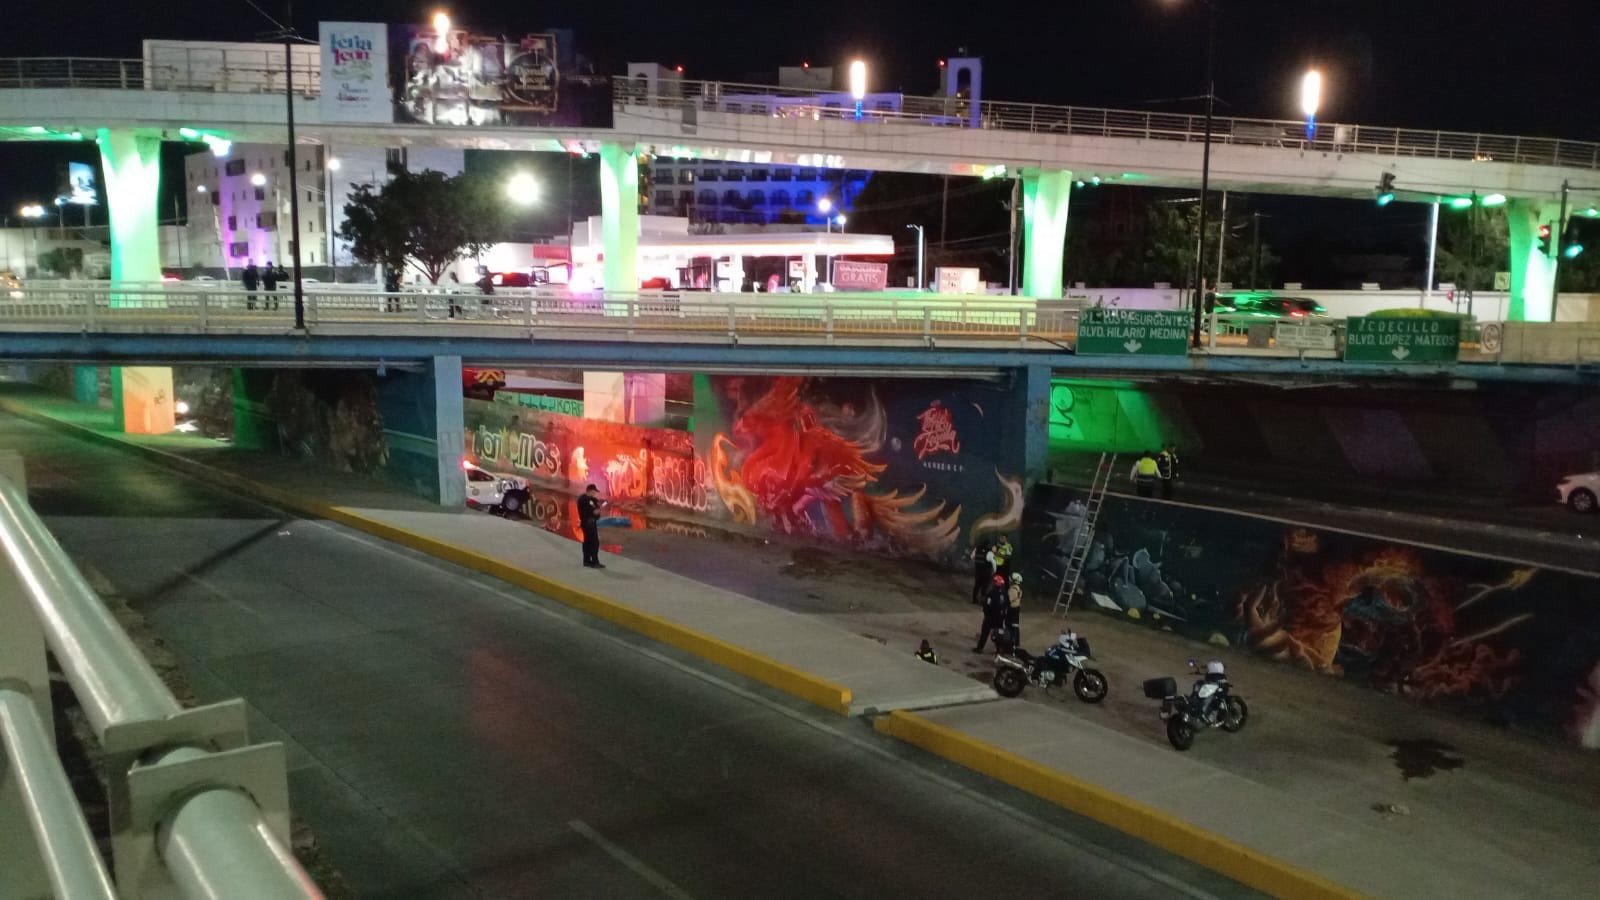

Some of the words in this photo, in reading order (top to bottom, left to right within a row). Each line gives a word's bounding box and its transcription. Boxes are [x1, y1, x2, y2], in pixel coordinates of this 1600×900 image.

[841, 272, 879, 284] GRATIS
[1107, 326, 1146, 338] HILARIO
[1150, 328, 1187, 340] MEDINA
[1415, 335, 1456, 346] MATEOS
